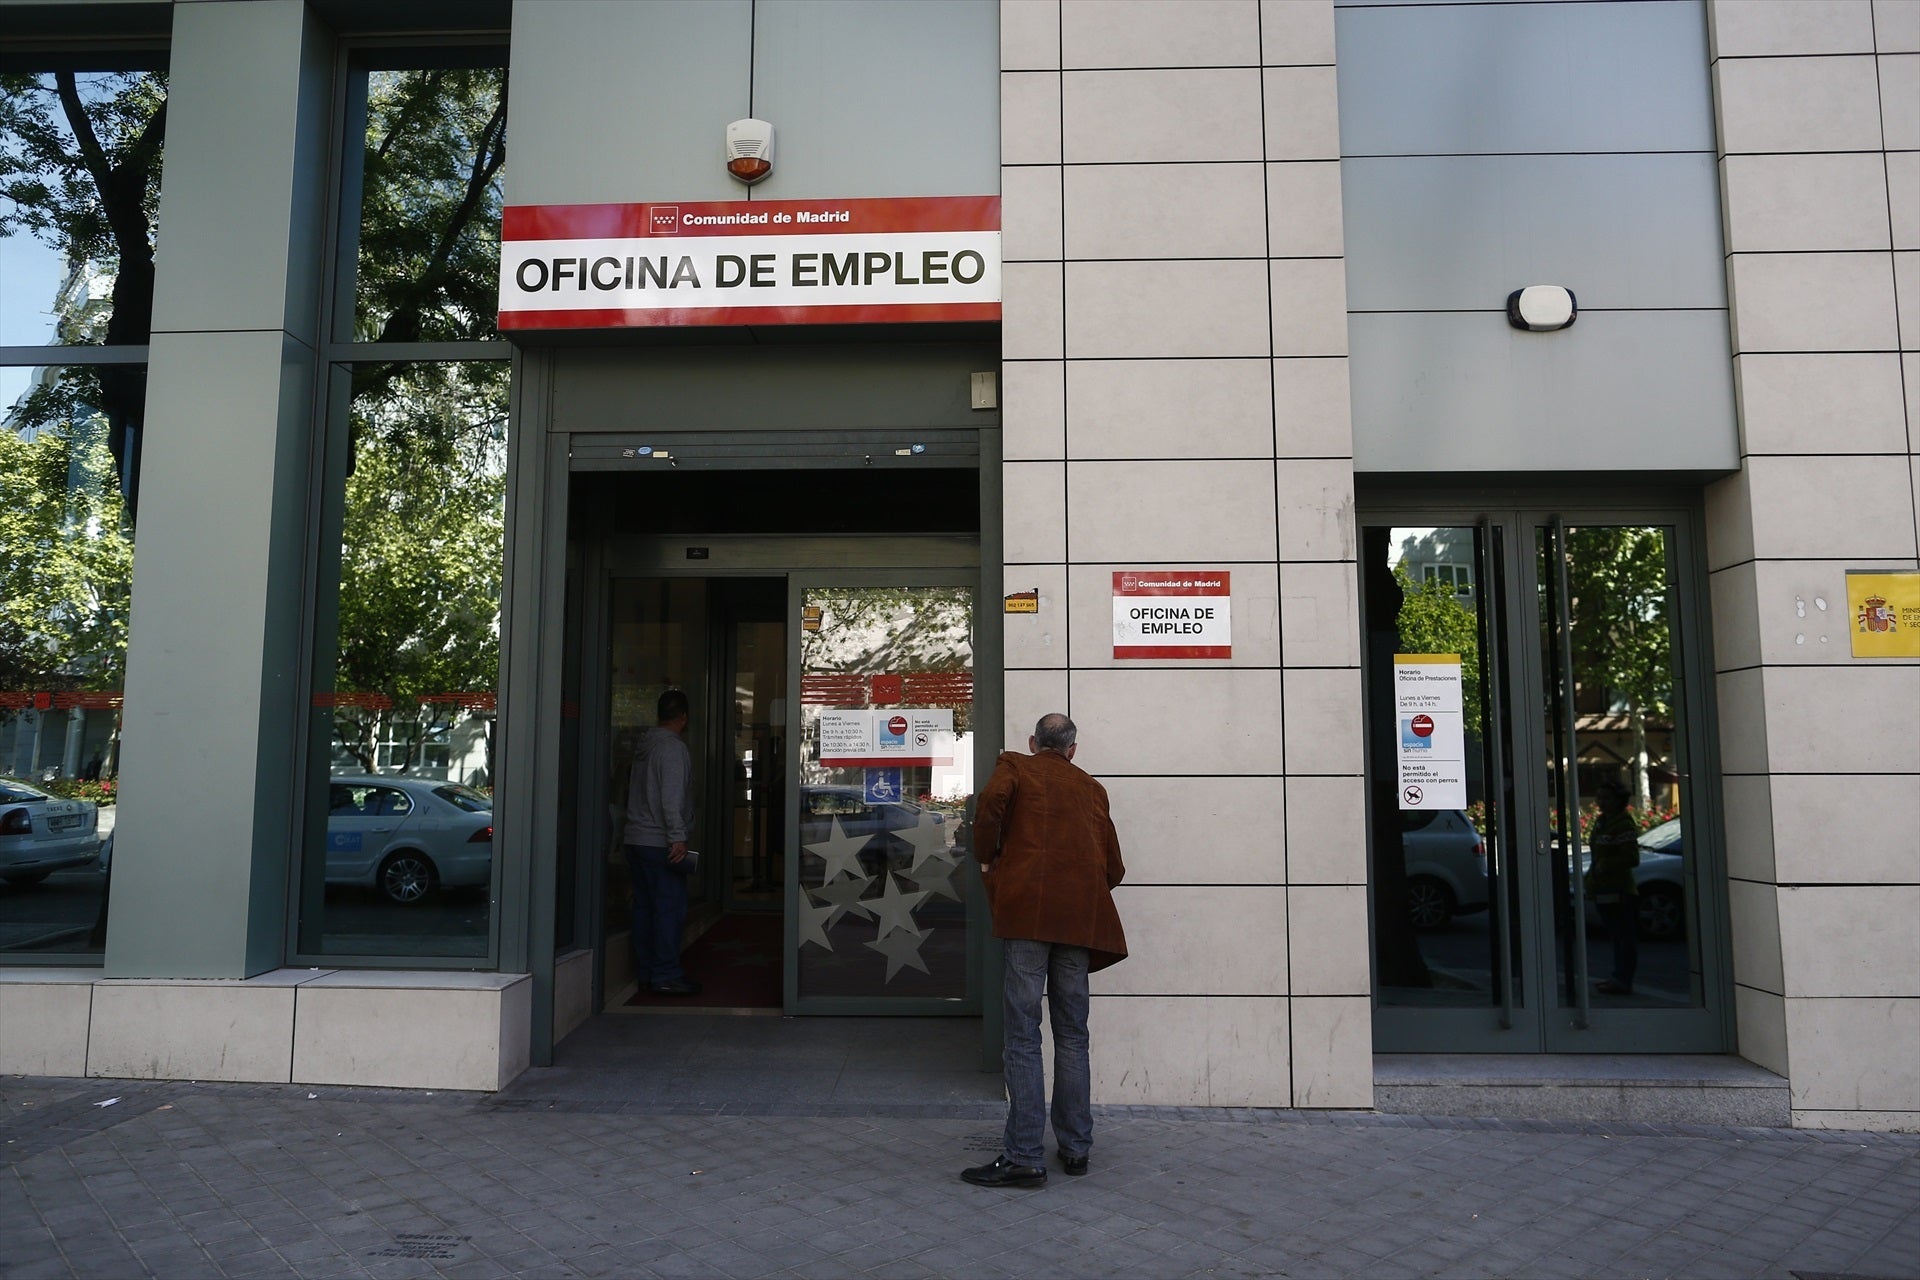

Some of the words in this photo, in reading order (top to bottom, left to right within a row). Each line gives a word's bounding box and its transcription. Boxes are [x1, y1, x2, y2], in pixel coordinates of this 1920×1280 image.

[682, 212, 768, 225] Comunidad
[772, 212, 792, 224] de
[796, 211, 850, 223] Madrid
[515, 255, 701, 292] OFICINA
[715, 254, 776, 289] DE
[791, 249, 986, 287] EMPLEO
[1138, 580, 1181, 588] Comunidad
[1129, 608, 1190, 620] OFICINA
[1194, 608, 1214, 619] DE
[1141, 622, 1203, 634] EMPLEO
